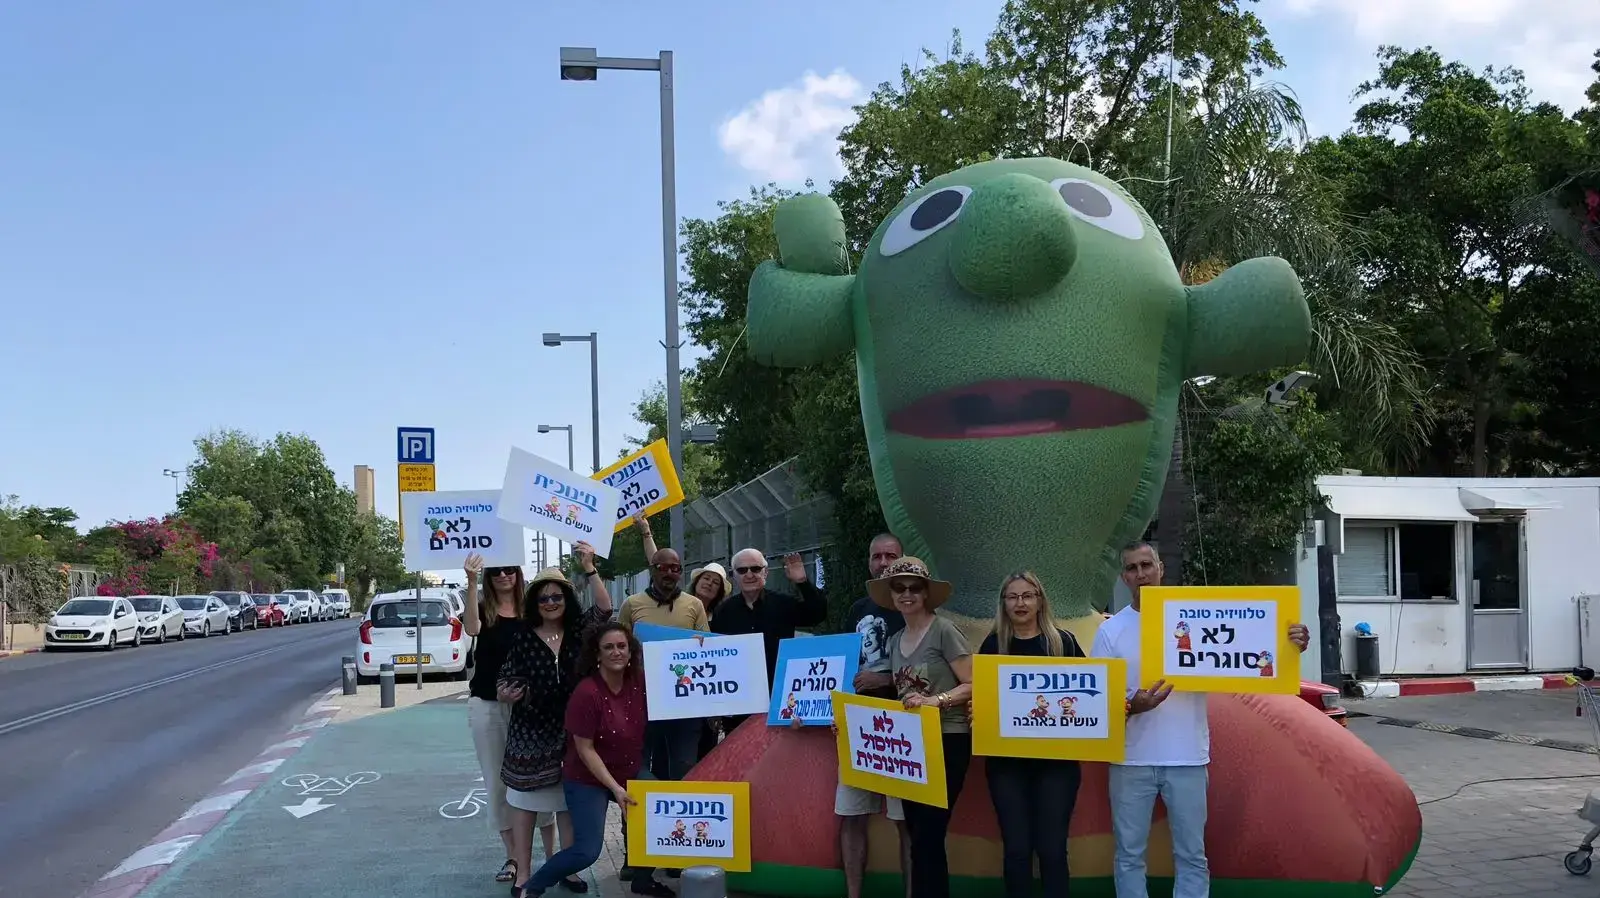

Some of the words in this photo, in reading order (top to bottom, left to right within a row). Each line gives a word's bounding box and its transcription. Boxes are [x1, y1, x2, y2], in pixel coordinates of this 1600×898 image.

[533, 473, 598, 507] חינוכית
[621, 481, 641, 501] לא
[427, 505, 452, 514] טובה
[455, 503, 493, 513] טלוויזיה
[616, 488, 660, 519] סוגרים
[529, 503, 563, 522] באהבה
[446, 516, 471, 533] לא
[564, 517, 593, 533] עושים
[429, 535, 493, 551] סוגרים
[1179, 608, 1211, 619] טובה
[1215, 607, 1266, 619] טלוויזיה
[1201, 623, 1235, 644] לא
[672, 650, 698, 660] טובה
[700, 647, 738, 659] טלוויזיה
[1178, 651, 1261, 669] סוגרים
[691, 661, 717, 679] לא
[808, 658, 828, 676] לא
[674, 680, 739, 697] סוגרים
[791, 676, 837, 692] סוגרים
[1008, 673, 1097, 690] חינוכית
[872, 710, 894, 734] לא
[1012, 716, 1057, 727] באהבה
[1060, 716, 1098, 727] עושים
[859, 725, 912, 756] לחיסול
[856, 749, 923, 779] החינוכית
[654, 799, 725, 815] חינוכית
[656, 837, 693, 847] באהבה
[694, 838, 726, 848] עושים
